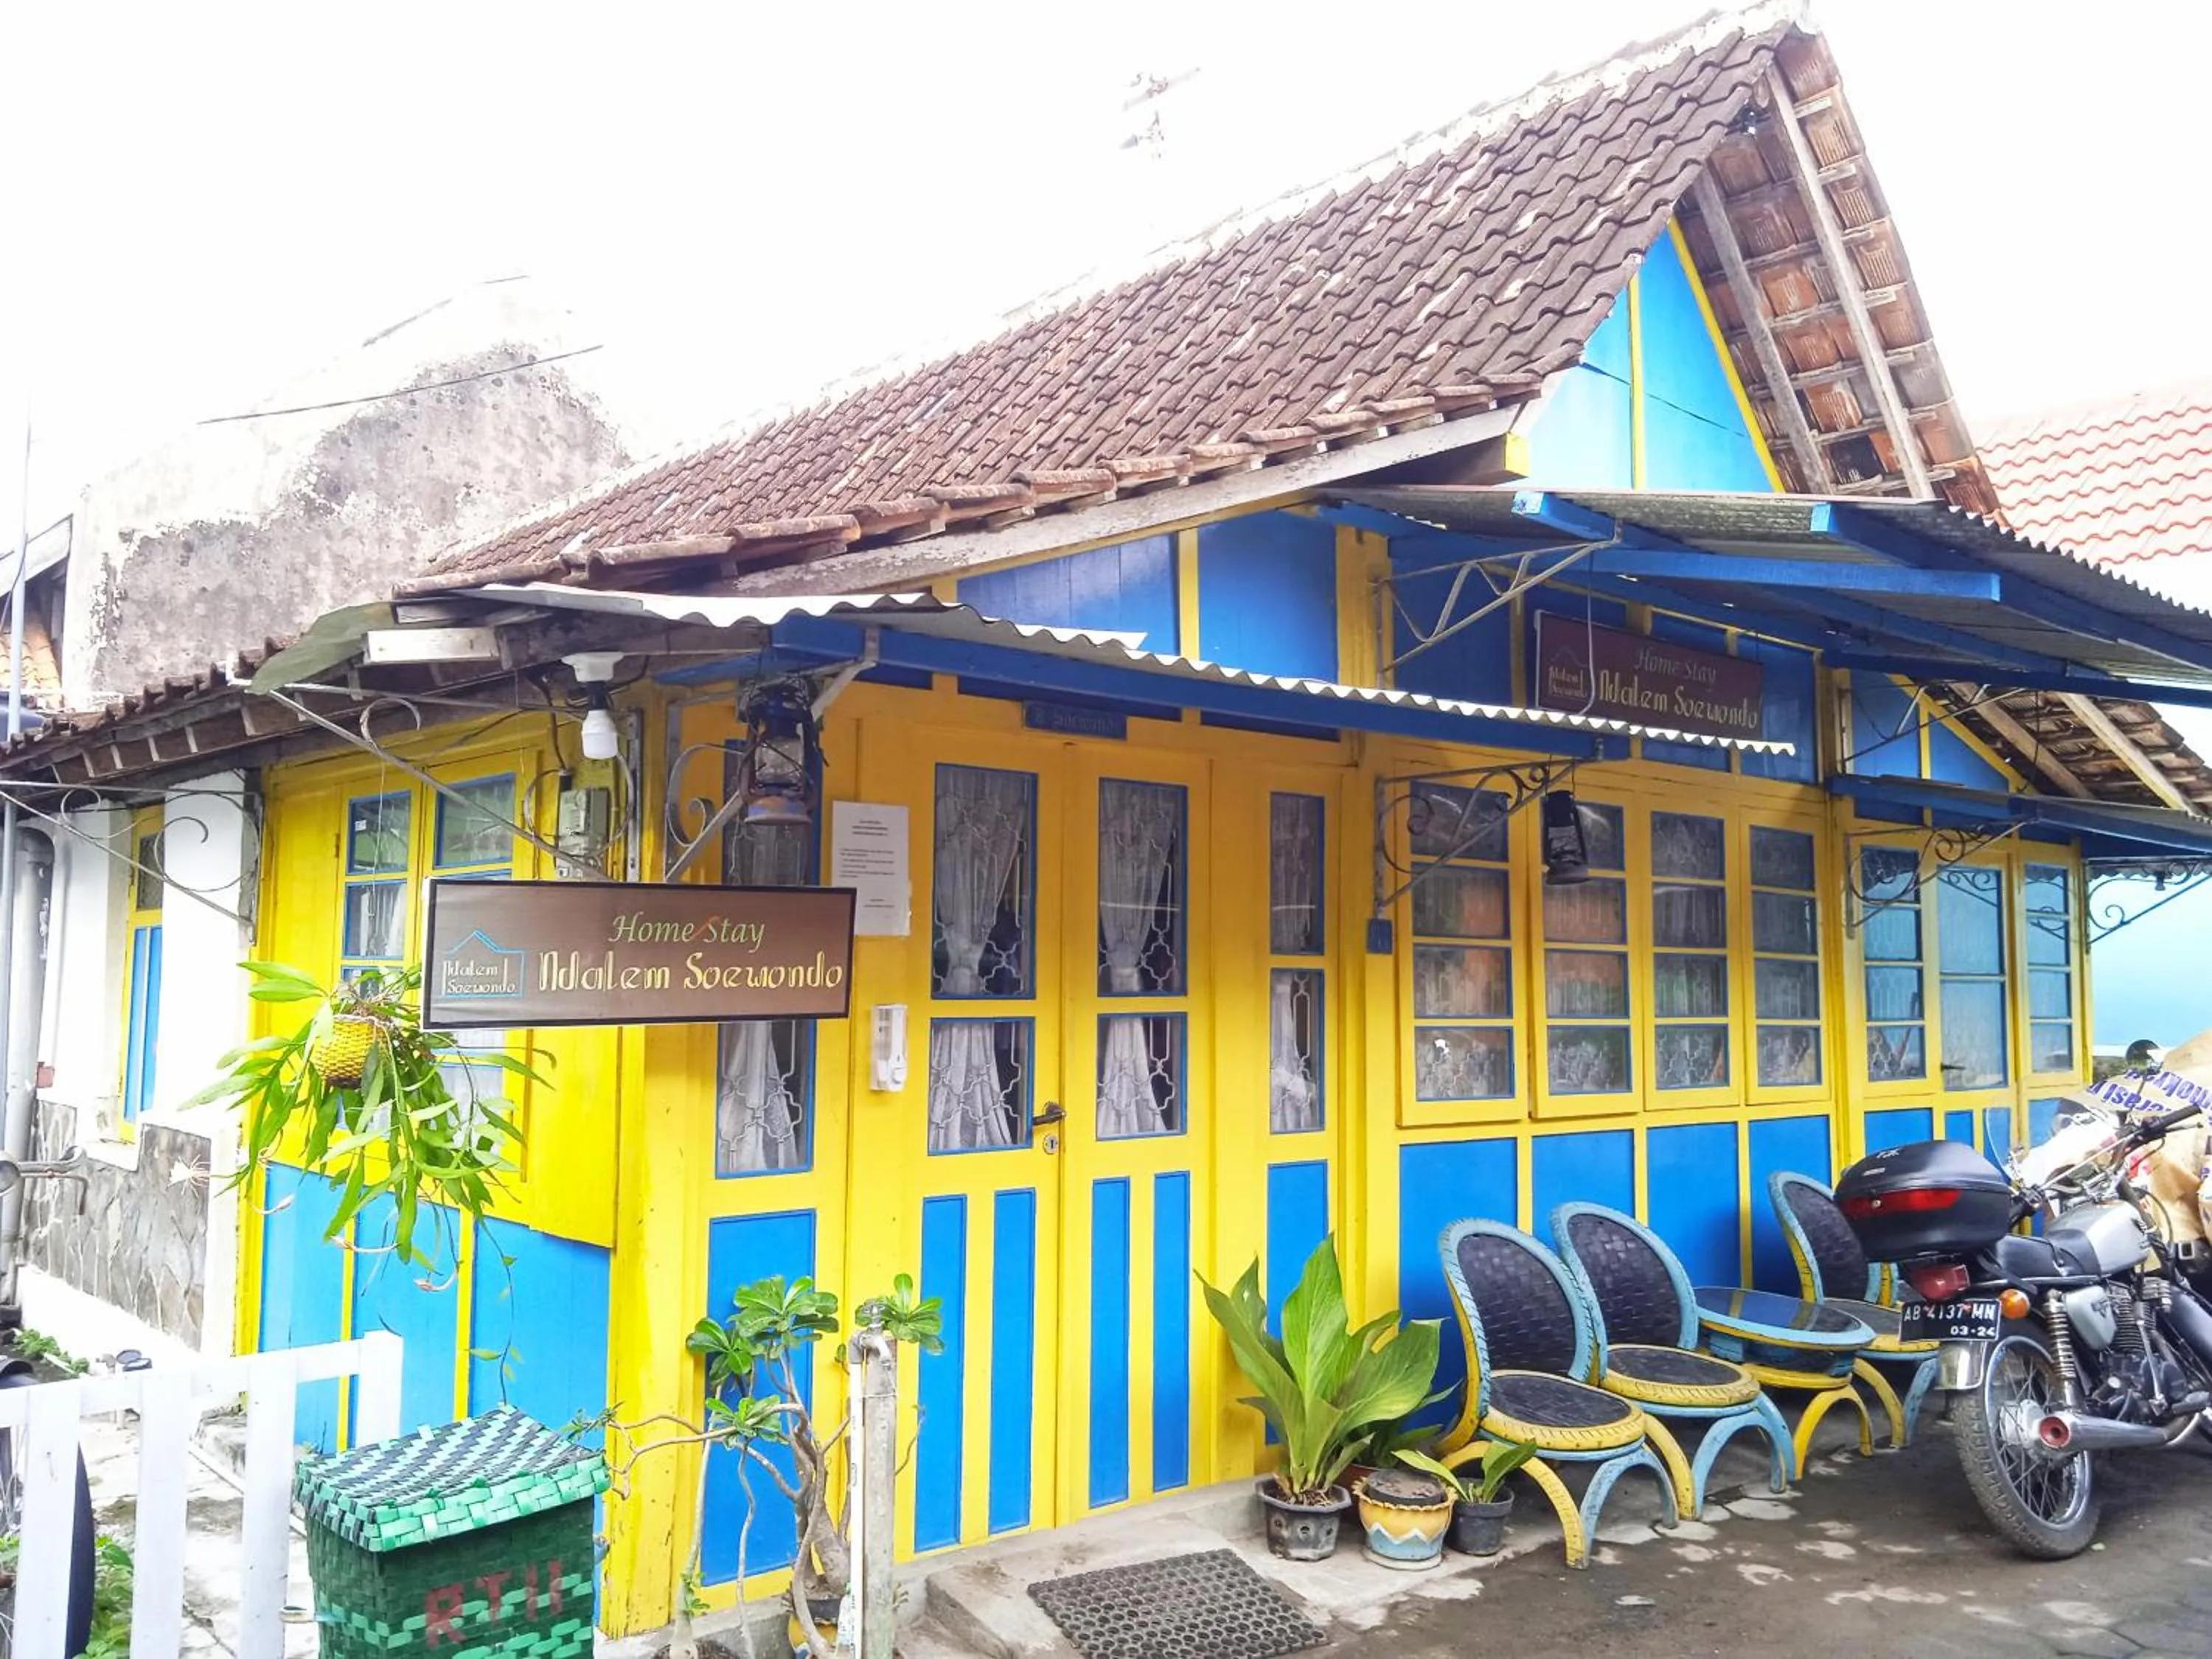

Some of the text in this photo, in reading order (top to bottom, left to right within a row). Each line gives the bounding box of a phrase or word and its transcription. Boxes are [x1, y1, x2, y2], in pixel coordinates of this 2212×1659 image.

[1633, 645, 1717, 692] Home Stay
[1599, 669, 1758, 729] Ndalem Soewondo
[608, 911, 765, 953] Home Stay
[538, 950, 844, 992] Ndalem Soewondo
[1904, 1304, 1921, 1322] AB
[1972, 1303, 1996, 1320] MN
